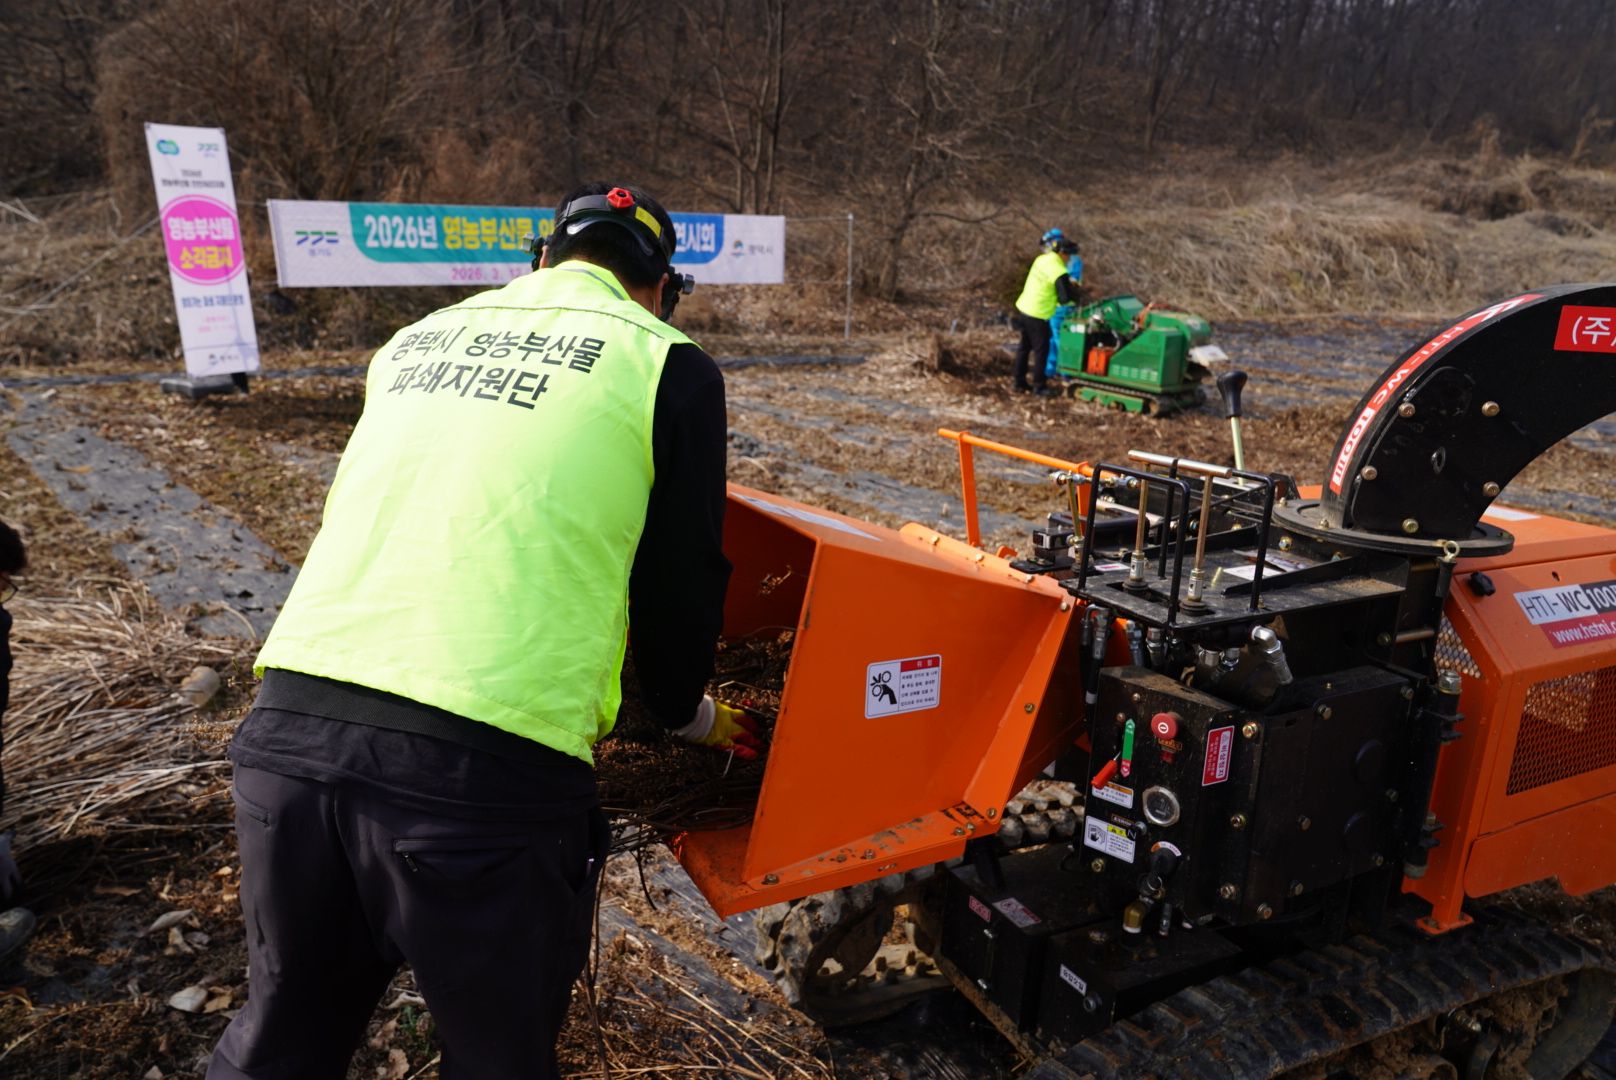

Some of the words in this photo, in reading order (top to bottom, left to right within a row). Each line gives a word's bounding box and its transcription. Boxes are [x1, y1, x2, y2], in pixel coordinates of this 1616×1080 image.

[167, 216, 236, 241] 영농부산물
[364, 215, 438, 249] 2026년
[391, 326, 467, 361] 평택시
[465, 331, 606, 374] 영농부산물
[387, 361, 551, 410] 파쇄지원단
[1520, 584, 1616, 620] HTI-WC100
